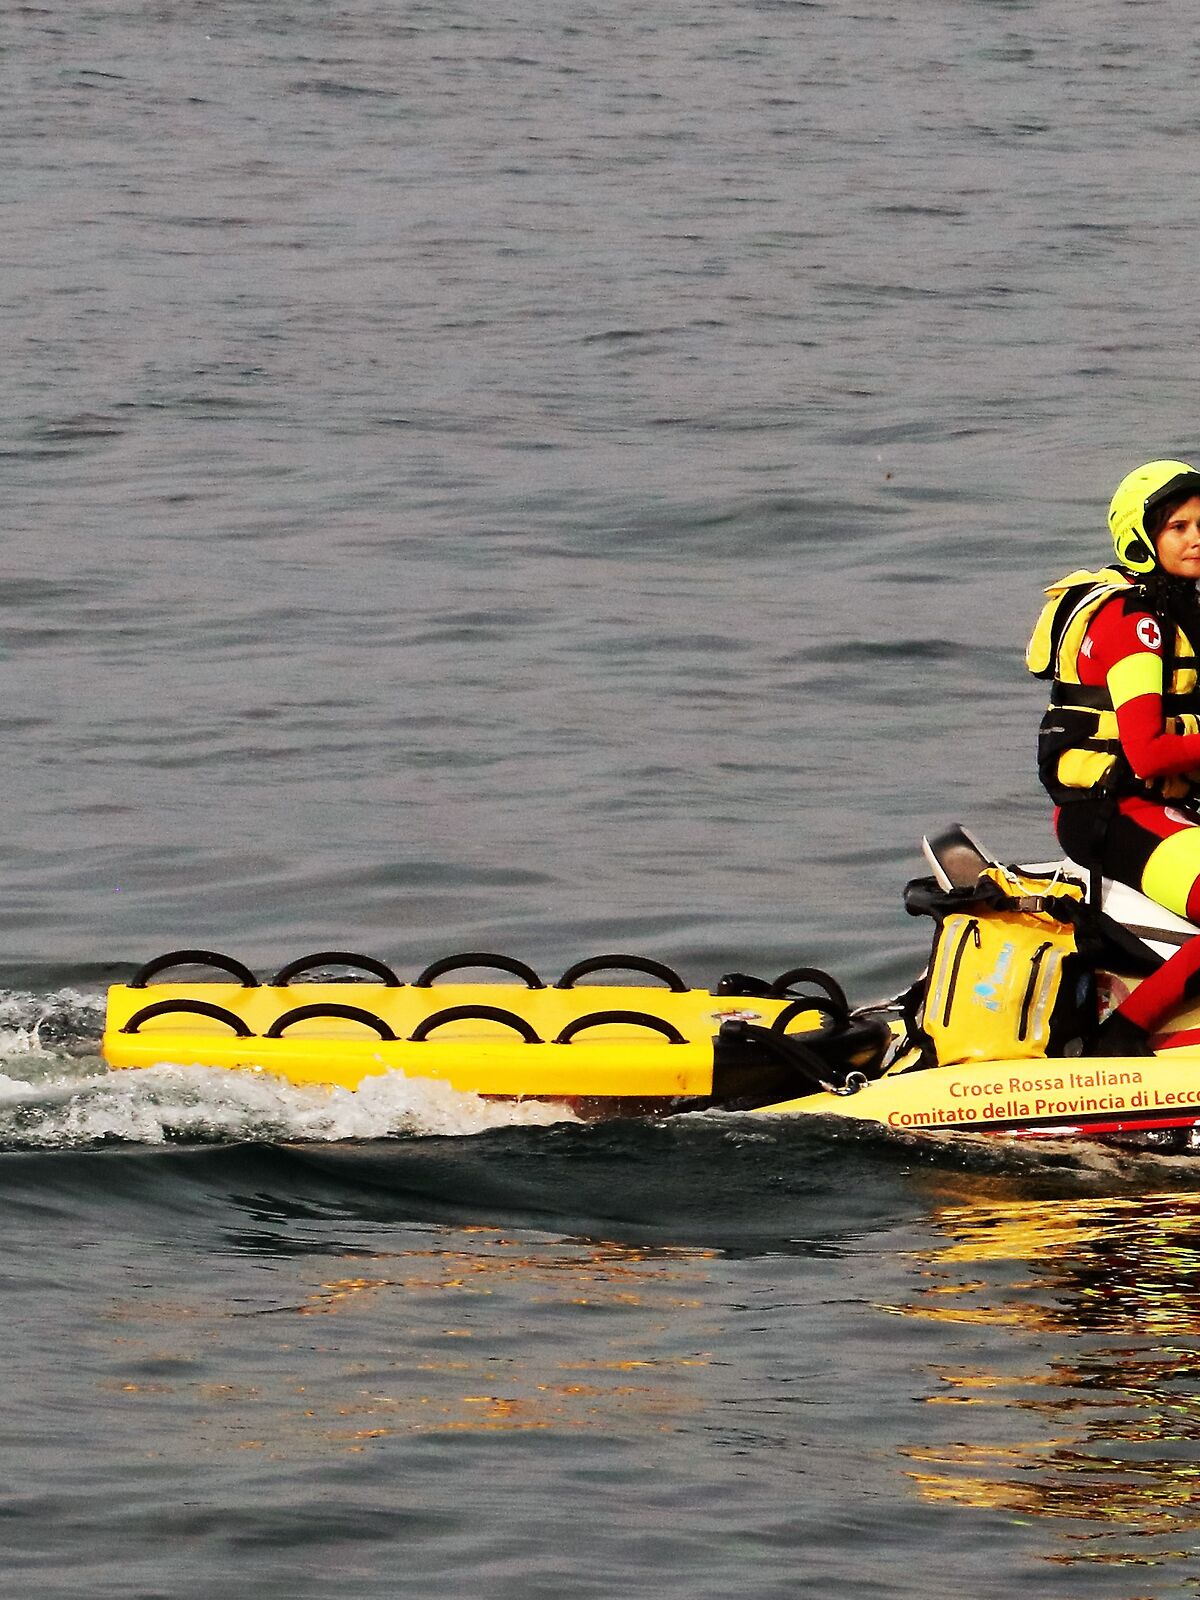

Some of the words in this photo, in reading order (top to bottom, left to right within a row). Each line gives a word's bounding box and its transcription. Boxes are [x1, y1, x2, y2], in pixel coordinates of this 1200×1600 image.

[949, 1082, 1004, 1098] Croce
[1009, 1077, 1065, 1093] Rossa
[1069, 1070, 1143, 1089] Italiana
[888, 1106, 977, 1127] Comitato
[982, 1100, 1030, 1120] della
[1035, 1094, 1126, 1115] Provincia
[1130, 1090, 1149, 1108] di
